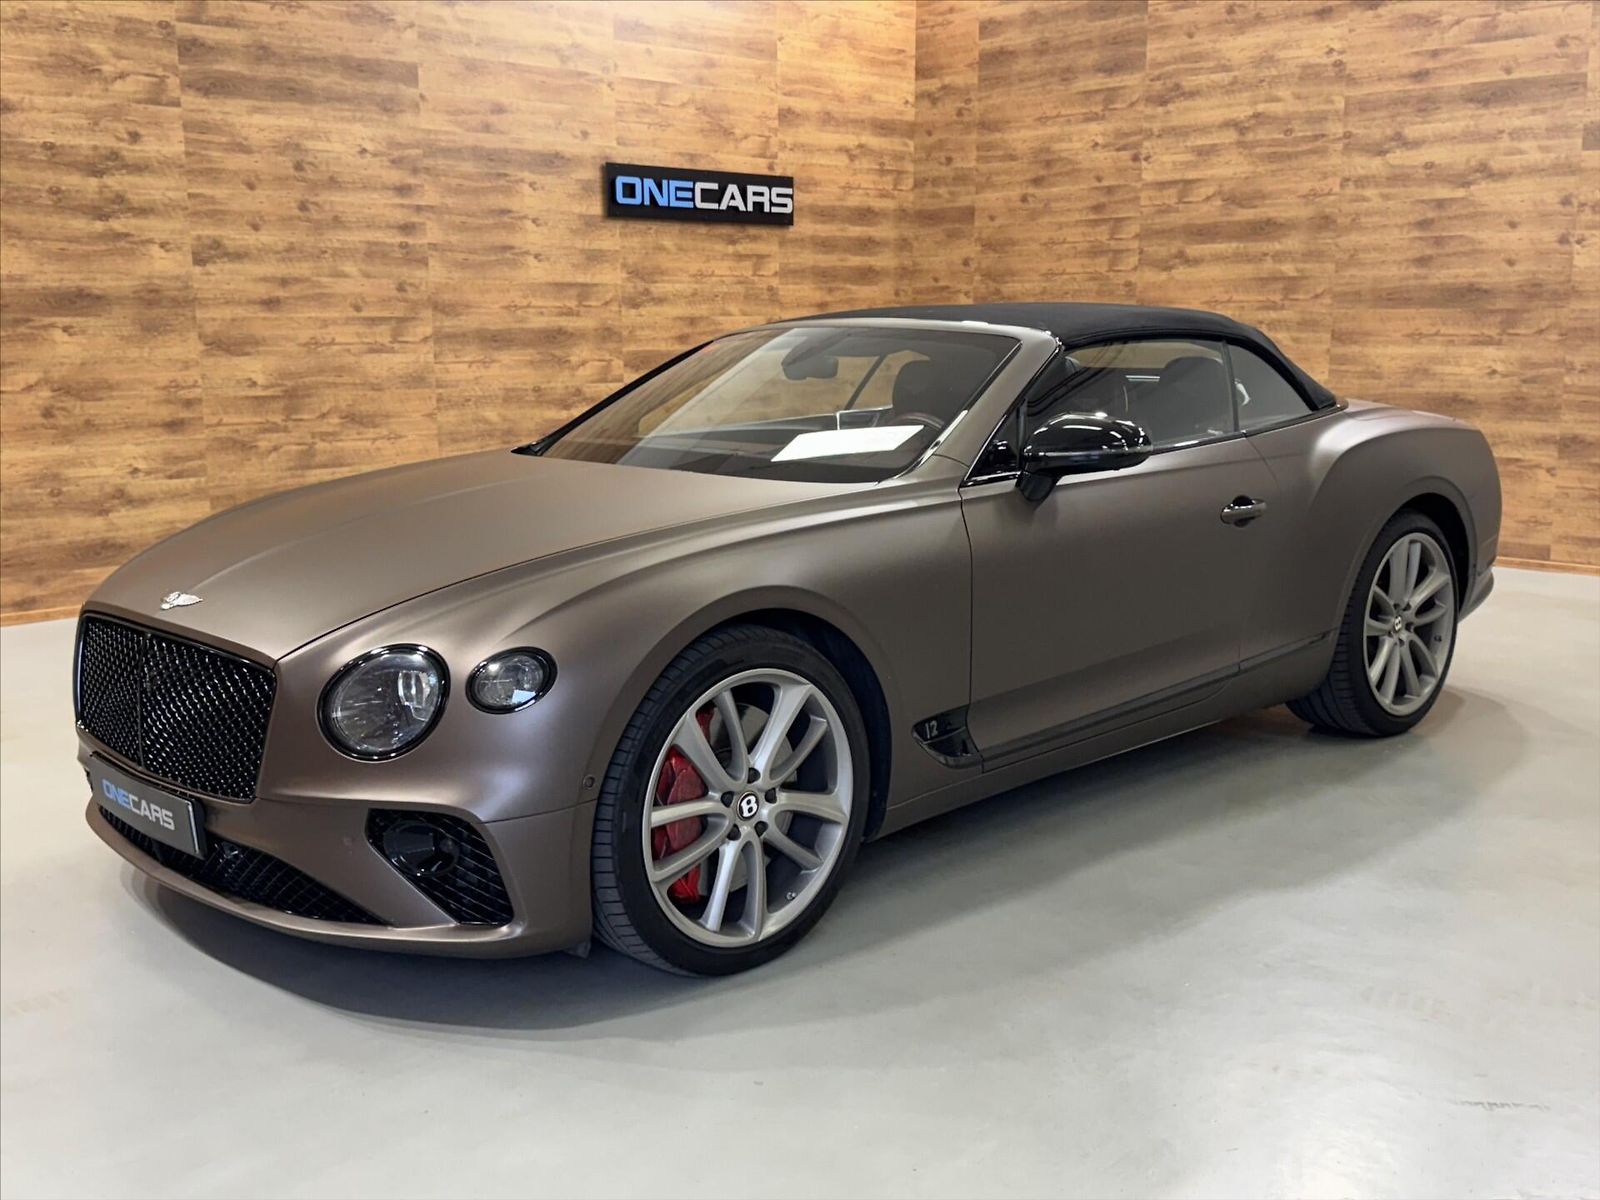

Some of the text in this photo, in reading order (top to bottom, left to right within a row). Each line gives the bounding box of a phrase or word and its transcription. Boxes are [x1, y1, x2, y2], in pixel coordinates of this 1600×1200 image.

[615, 176, 793, 214] ONECARS
[925, 720, 938, 739] 12
[102, 778, 175, 831] ONECARS
